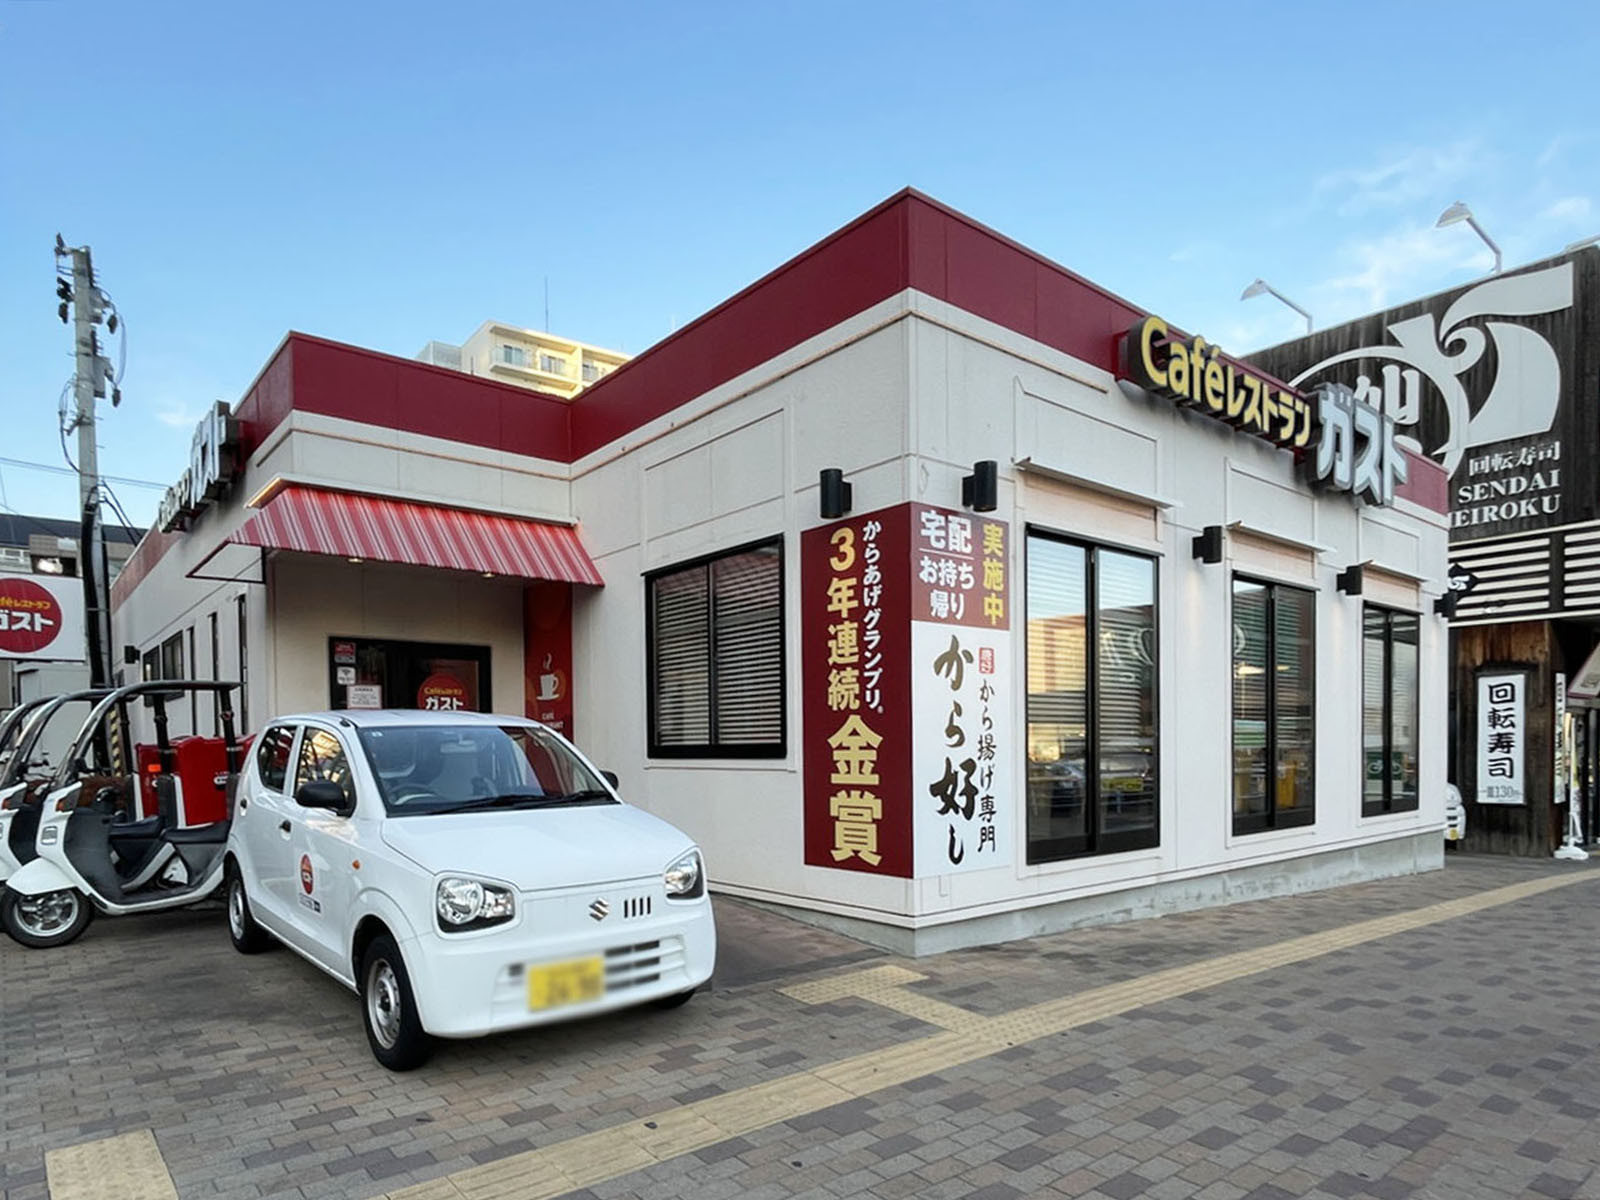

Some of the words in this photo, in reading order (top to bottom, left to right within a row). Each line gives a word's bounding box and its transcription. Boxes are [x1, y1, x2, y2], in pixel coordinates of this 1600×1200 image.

[1317, 386, 1408, 505] ガスト
[1469, 441, 1561, 476] 回転寿司
[1458, 469, 1561, 503] SENDAI
[919, 510, 973, 554] 宅配
[919, 555, 975, 590] お持ち
[929, 589, 966, 620] 帰り
[982, 523, 1005, 626] 実施中
[862, 520, 883, 710] からあげグランプリ
[426, 696, 464, 710] ガスト
[1487, 682, 1516, 779] 回転寿司
[929, 634, 979, 865] から好し
[977, 677, 997, 853] から揚げ専門
